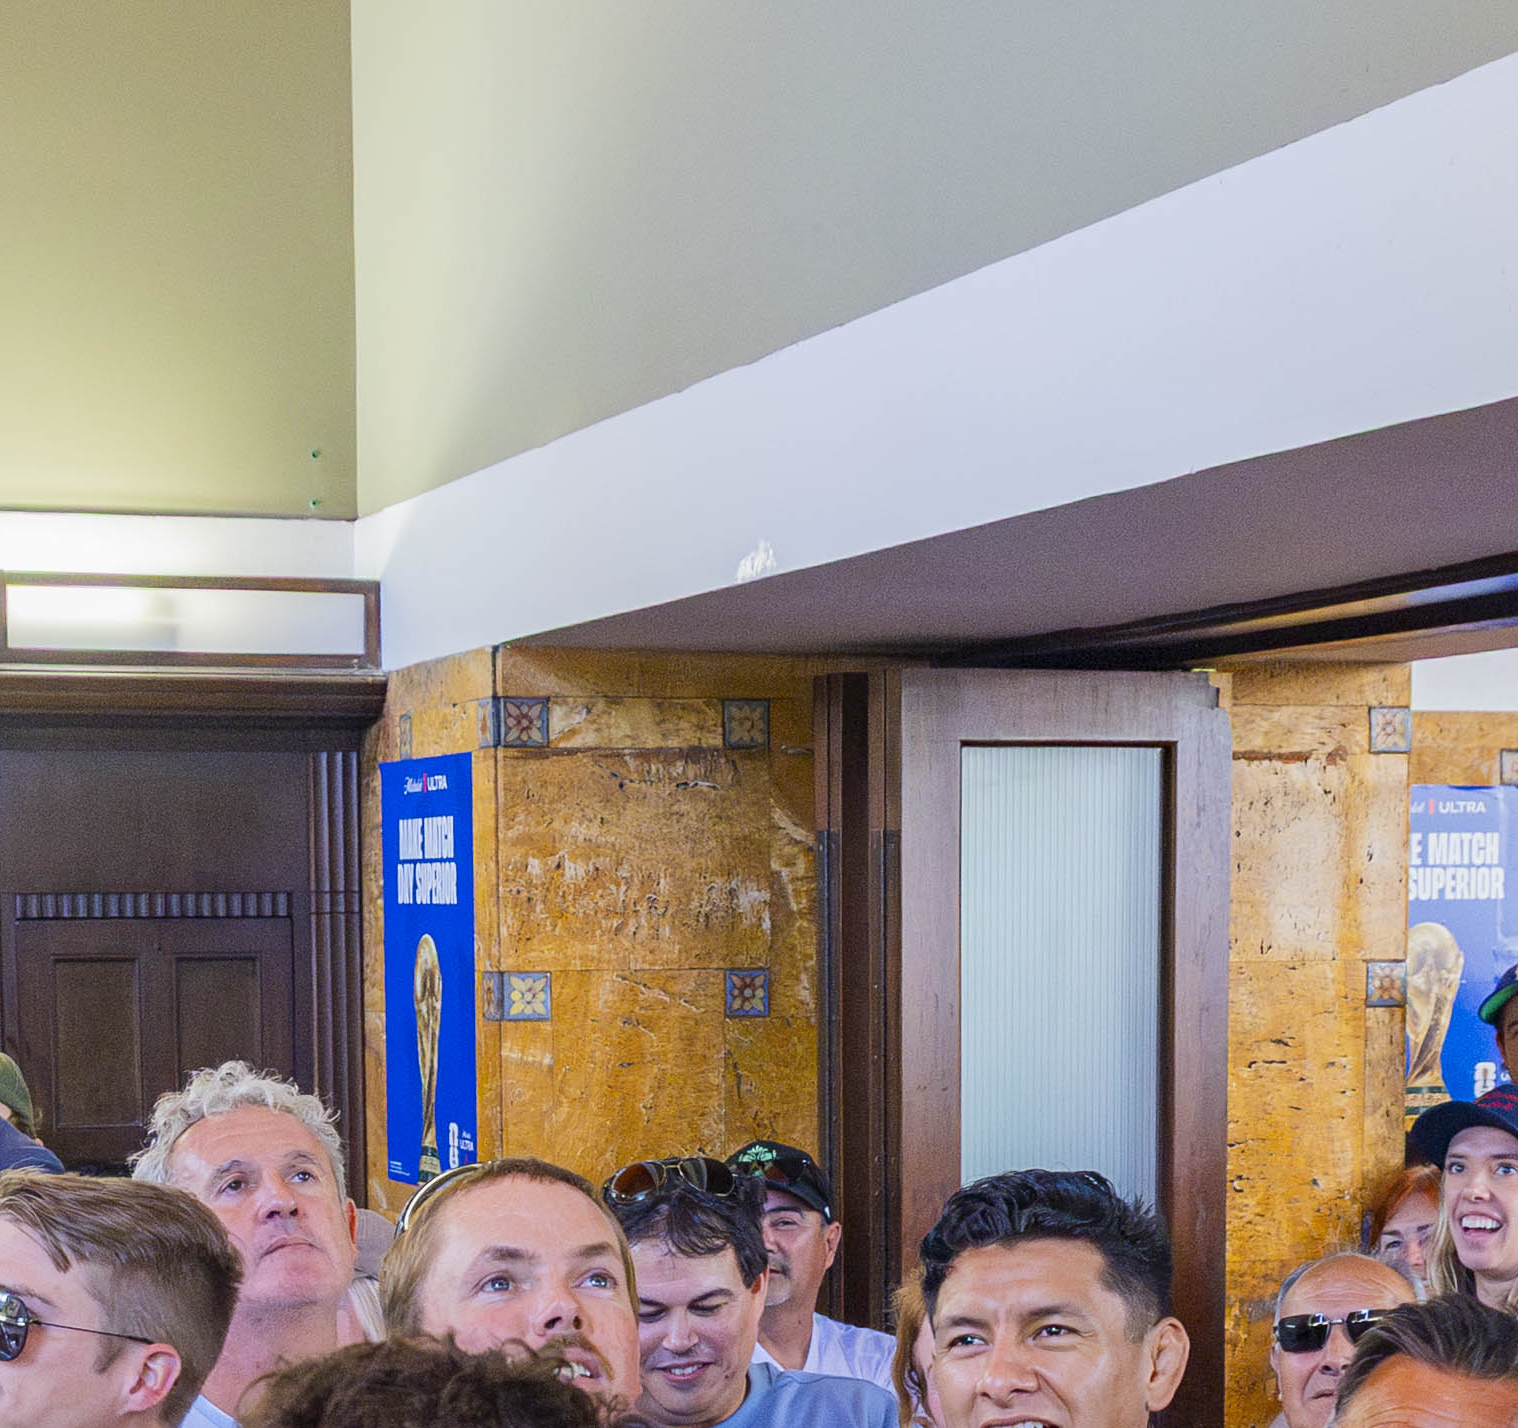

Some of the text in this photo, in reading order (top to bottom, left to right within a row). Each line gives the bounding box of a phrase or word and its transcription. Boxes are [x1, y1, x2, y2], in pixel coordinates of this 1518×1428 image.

[1438, 801, 1487, 814] ULTRA
[399, 816, 454, 860] MAKE MATCH
[1428, 832, 1500, 865] MATCH
[397, 862, 458, 905] DAY SUPERIOR
[1409, 867, 1505, 901] SUPERIOR
